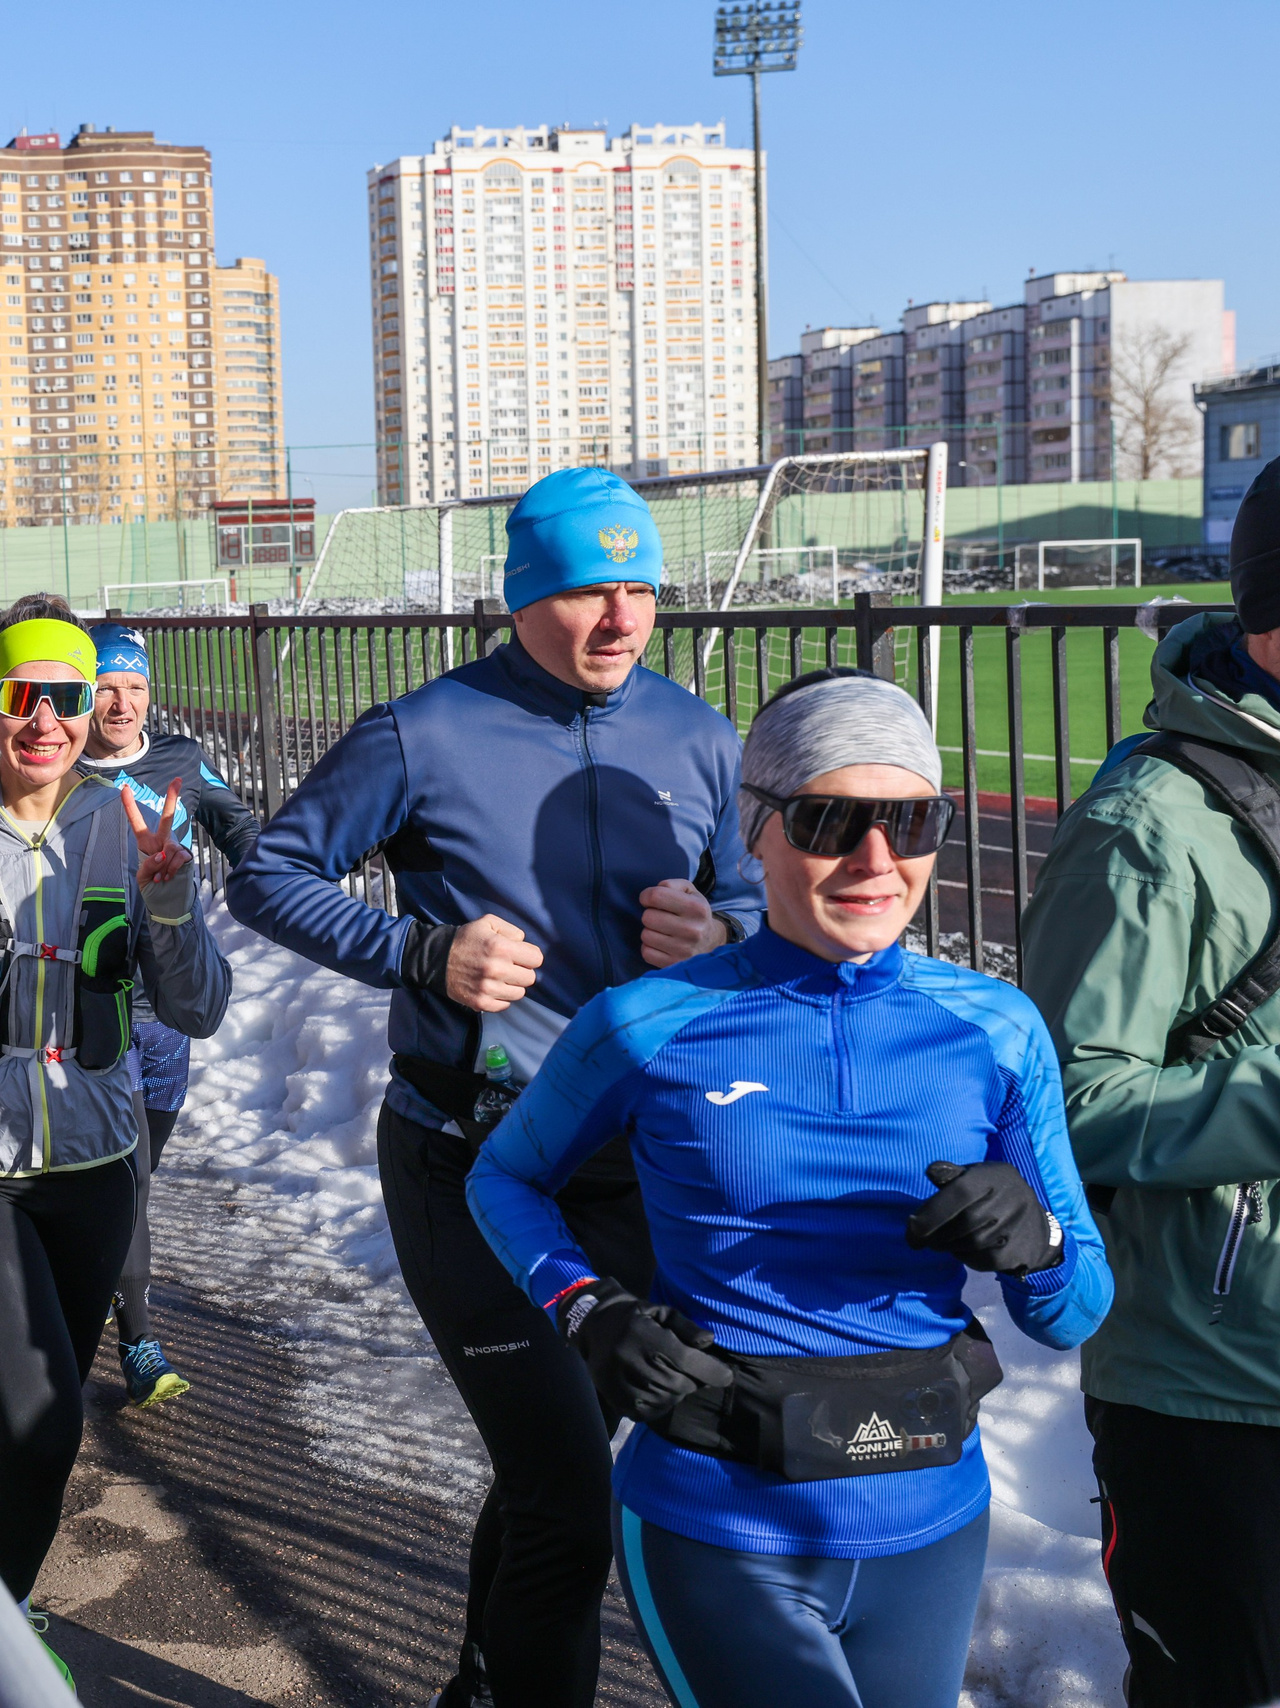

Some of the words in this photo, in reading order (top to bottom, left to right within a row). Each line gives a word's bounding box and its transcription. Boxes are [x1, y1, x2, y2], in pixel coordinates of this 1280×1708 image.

[475, 1340, 530, 1354] NORDSKI
[846, 1440, 903, 1454] AONIJIE
[851, 1451, 897, 1461] RUNNING
